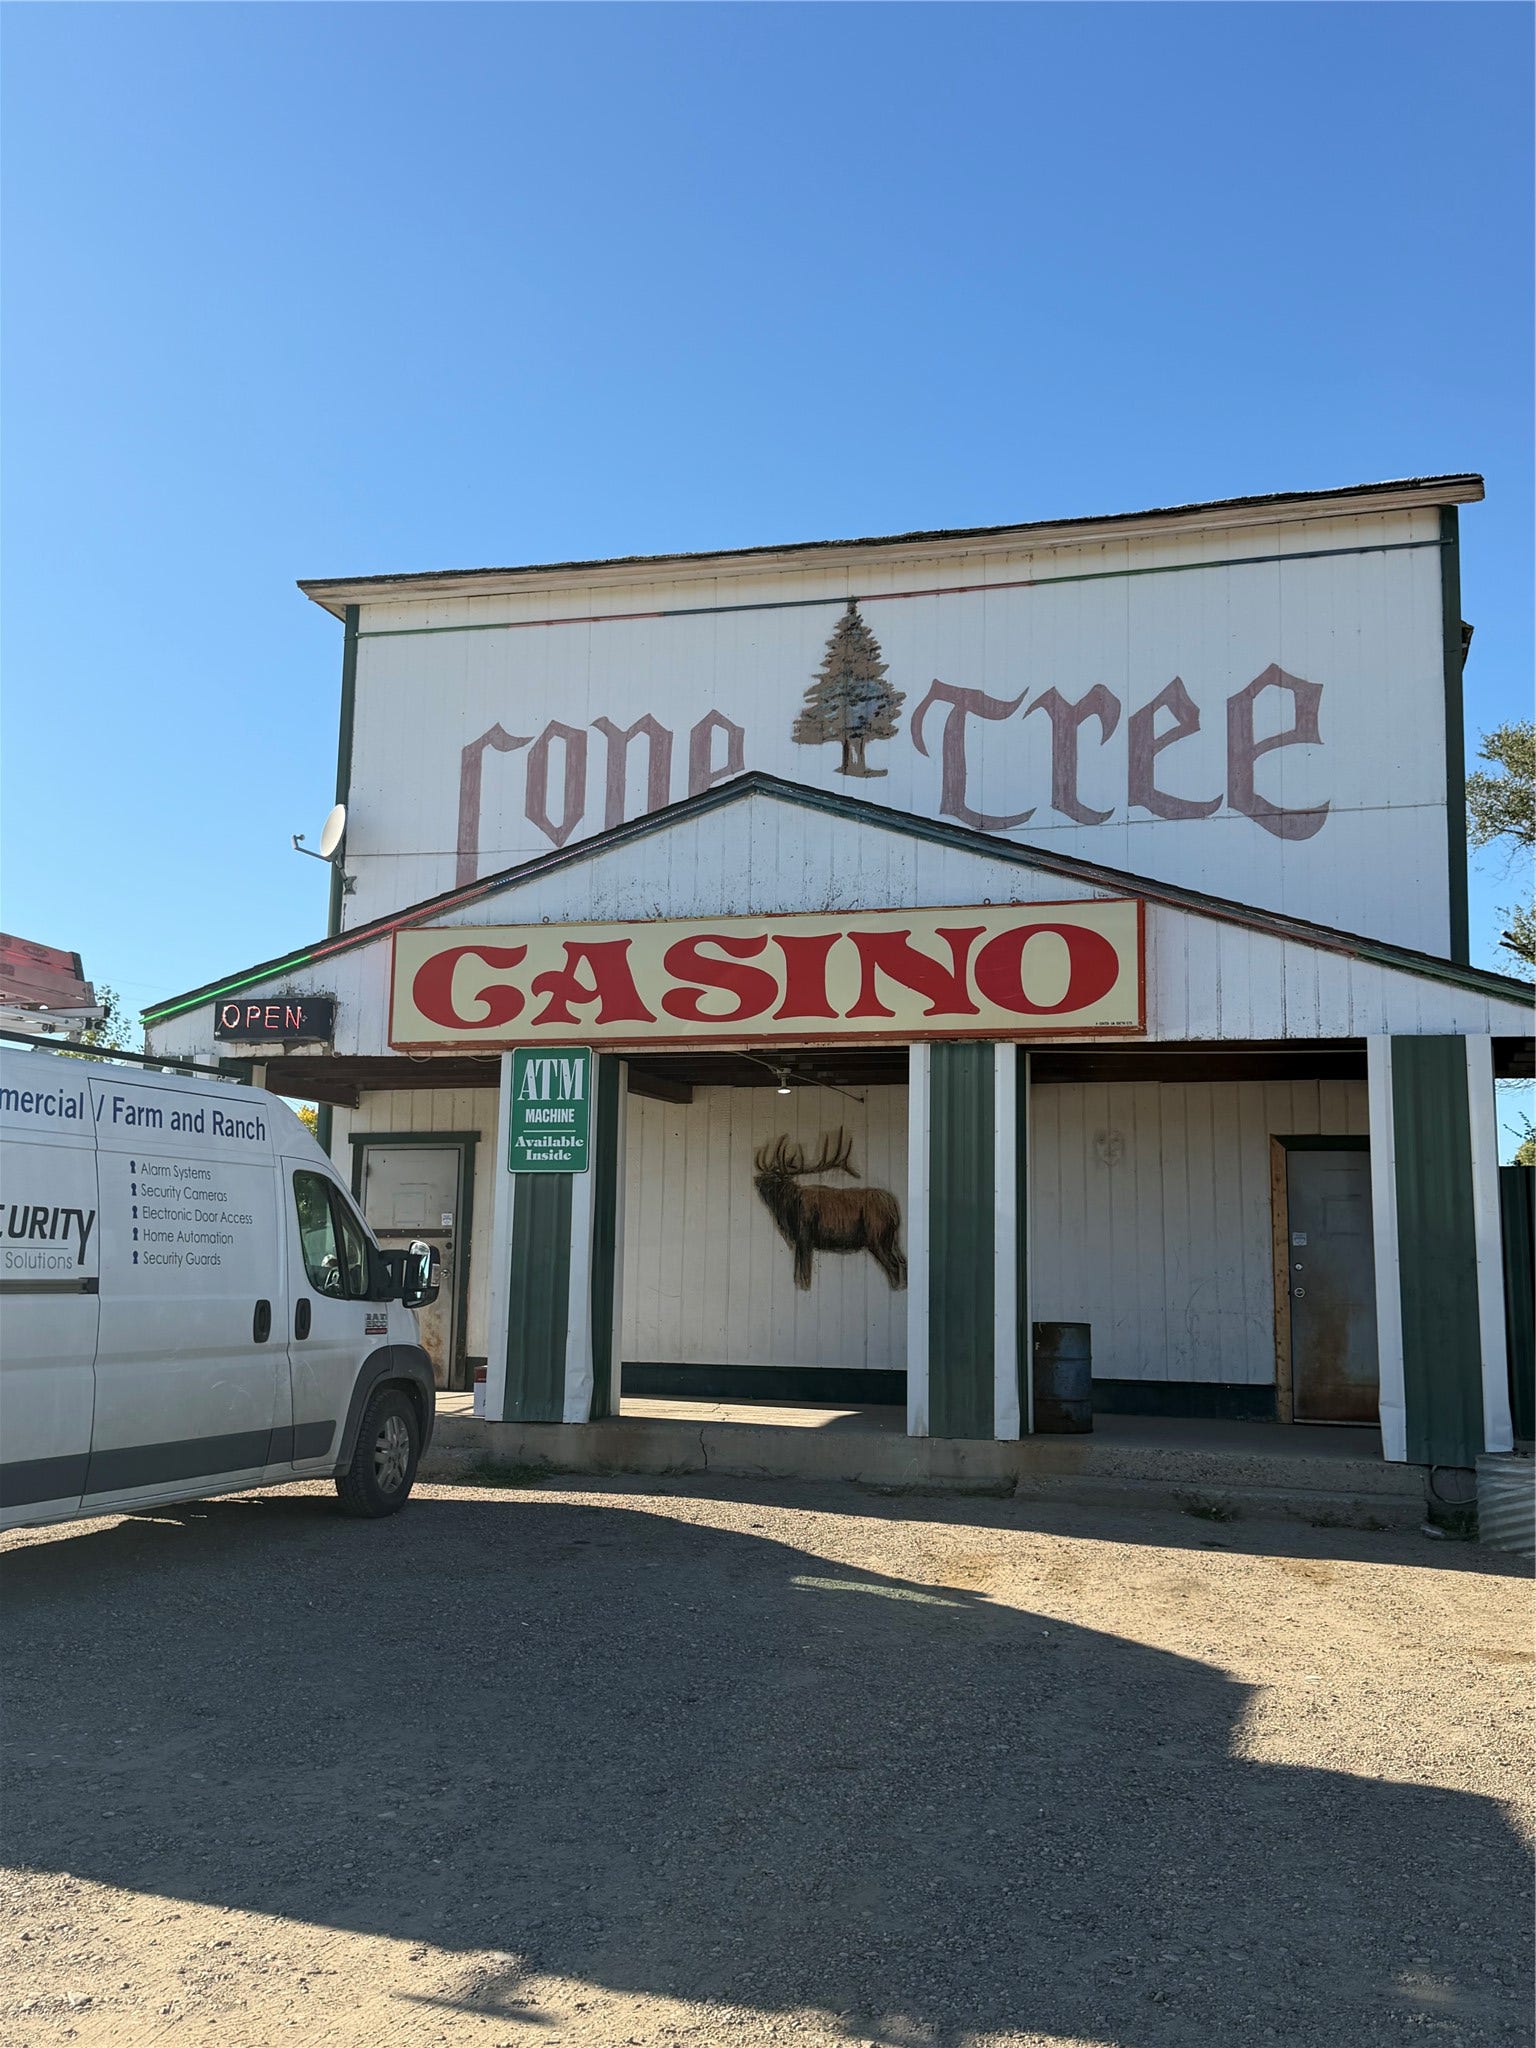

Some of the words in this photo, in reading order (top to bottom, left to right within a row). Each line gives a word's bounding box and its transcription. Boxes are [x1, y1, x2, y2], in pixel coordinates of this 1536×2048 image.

[910, 663, 1331, 842] Tree
[412, 922, 1121, 1030] CASINO
[221, 1004, 302, 1029] OPEN
[517, 1058, 585, 1101] ATM
[112, 1096, 163, 1128] Farm
[171, 1109, 205, 1133] and
[212, 1110, 266, 1141] Ranch
[525, 1108, 575, 1123] MACHINE
[515, 1136, 584, 1148] Available
[526, 1149, 572, 1160] Inside
[140, 1162, 171, 1177] Alarm
[173, 1164, 211, 1181] Systems
[141, 1183, 181, 1201] Security
[183, 1186, 228, 1202] Cameras
[142, 1206, 192, 1221] Electronic
[195, 1209, 218, 1222] Door
[220, 1211, 253, 1224] Access
[143, 1228, 174, 1242] Home
[177, 1230, 234, 1244] Automation
[5, 1251, 73, 1269] Solutions
[143, 1251, 183, 1268] Security
[186, 1252, 221, 1266] Guards
